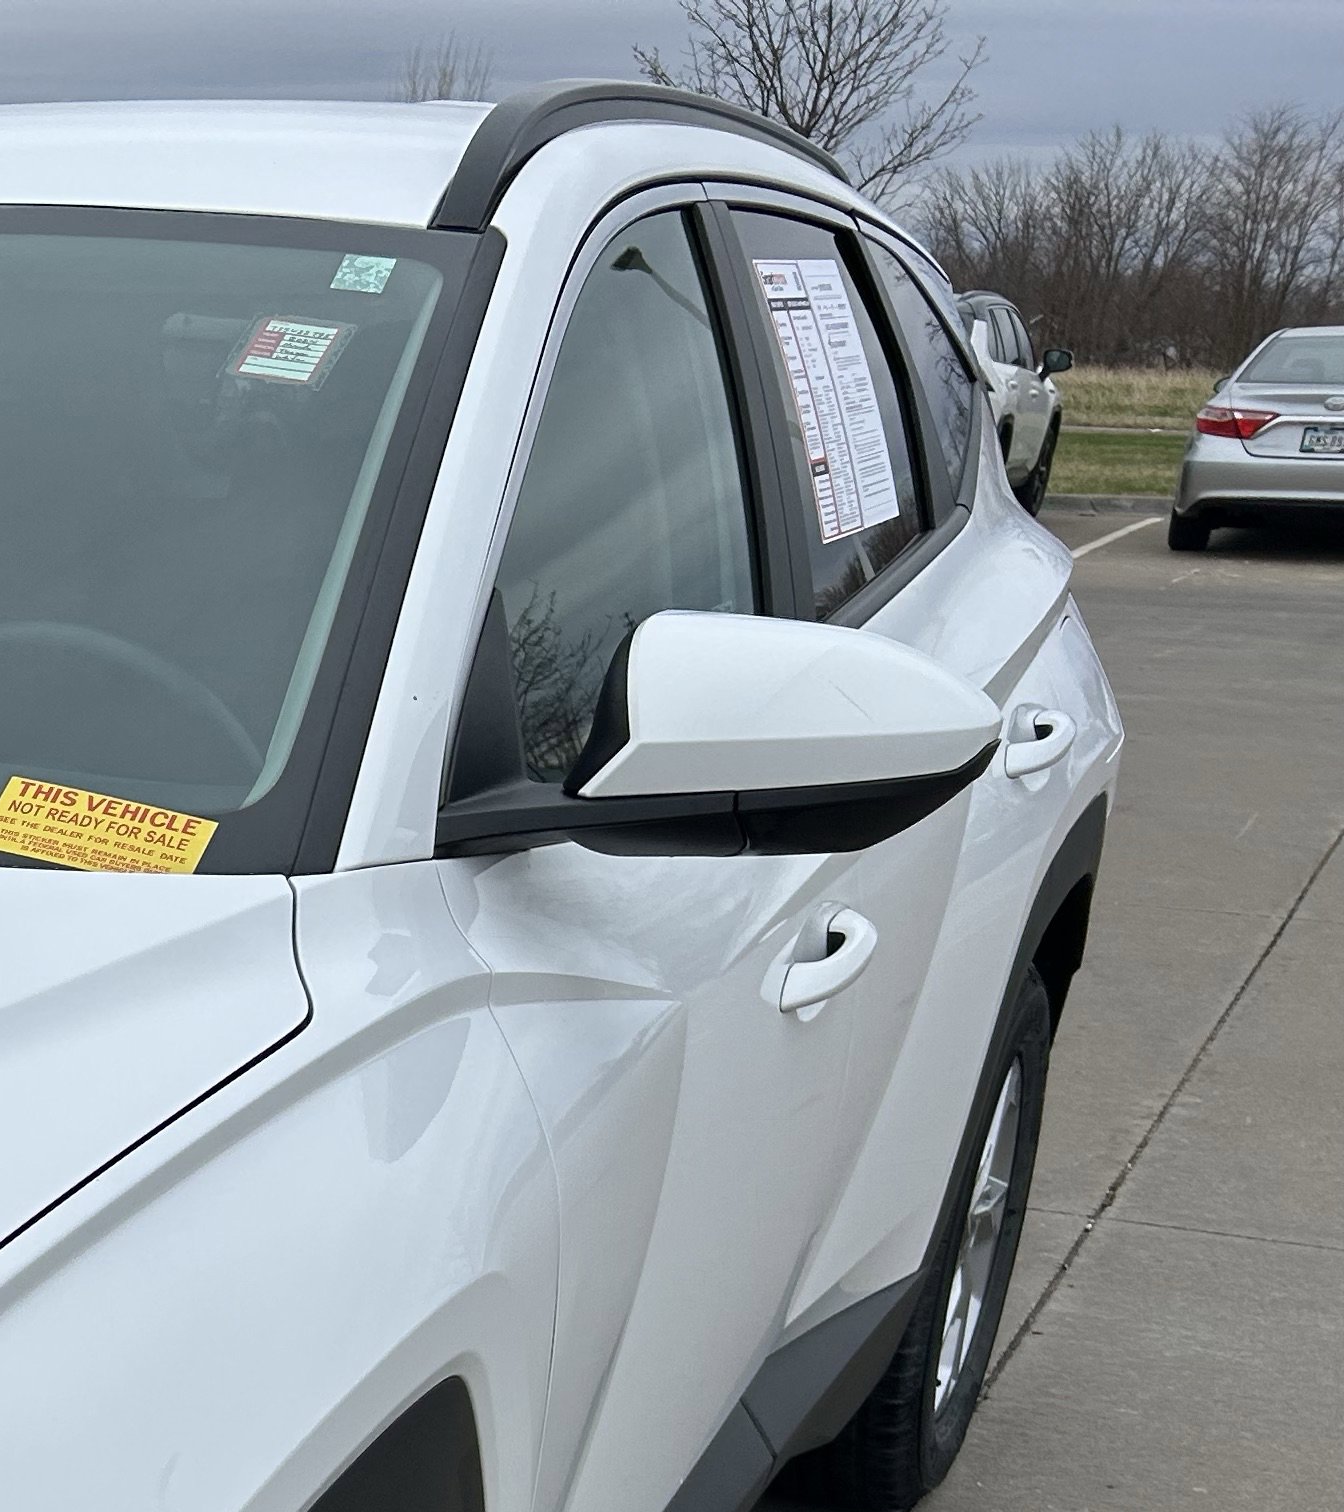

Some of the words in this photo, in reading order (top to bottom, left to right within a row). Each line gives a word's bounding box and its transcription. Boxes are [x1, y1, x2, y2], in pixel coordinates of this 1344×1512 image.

[7, 800, 45, 816] NOT
[45, 807, 105, 830] READY
[105, 821, 142, 839] FOR
[144, 830, 190, 851] SALE
[18, 780, 79, 807] THIS
[87, 795, 202, 836] VEHICLE
[21, 820, 40, 830] THE
[43, 825, 84, 839] DEALER
[87, 835, 109, 845] FOR
[113, 841, 155, 857] RESALE
[159, 852, 188, 864] DATE
